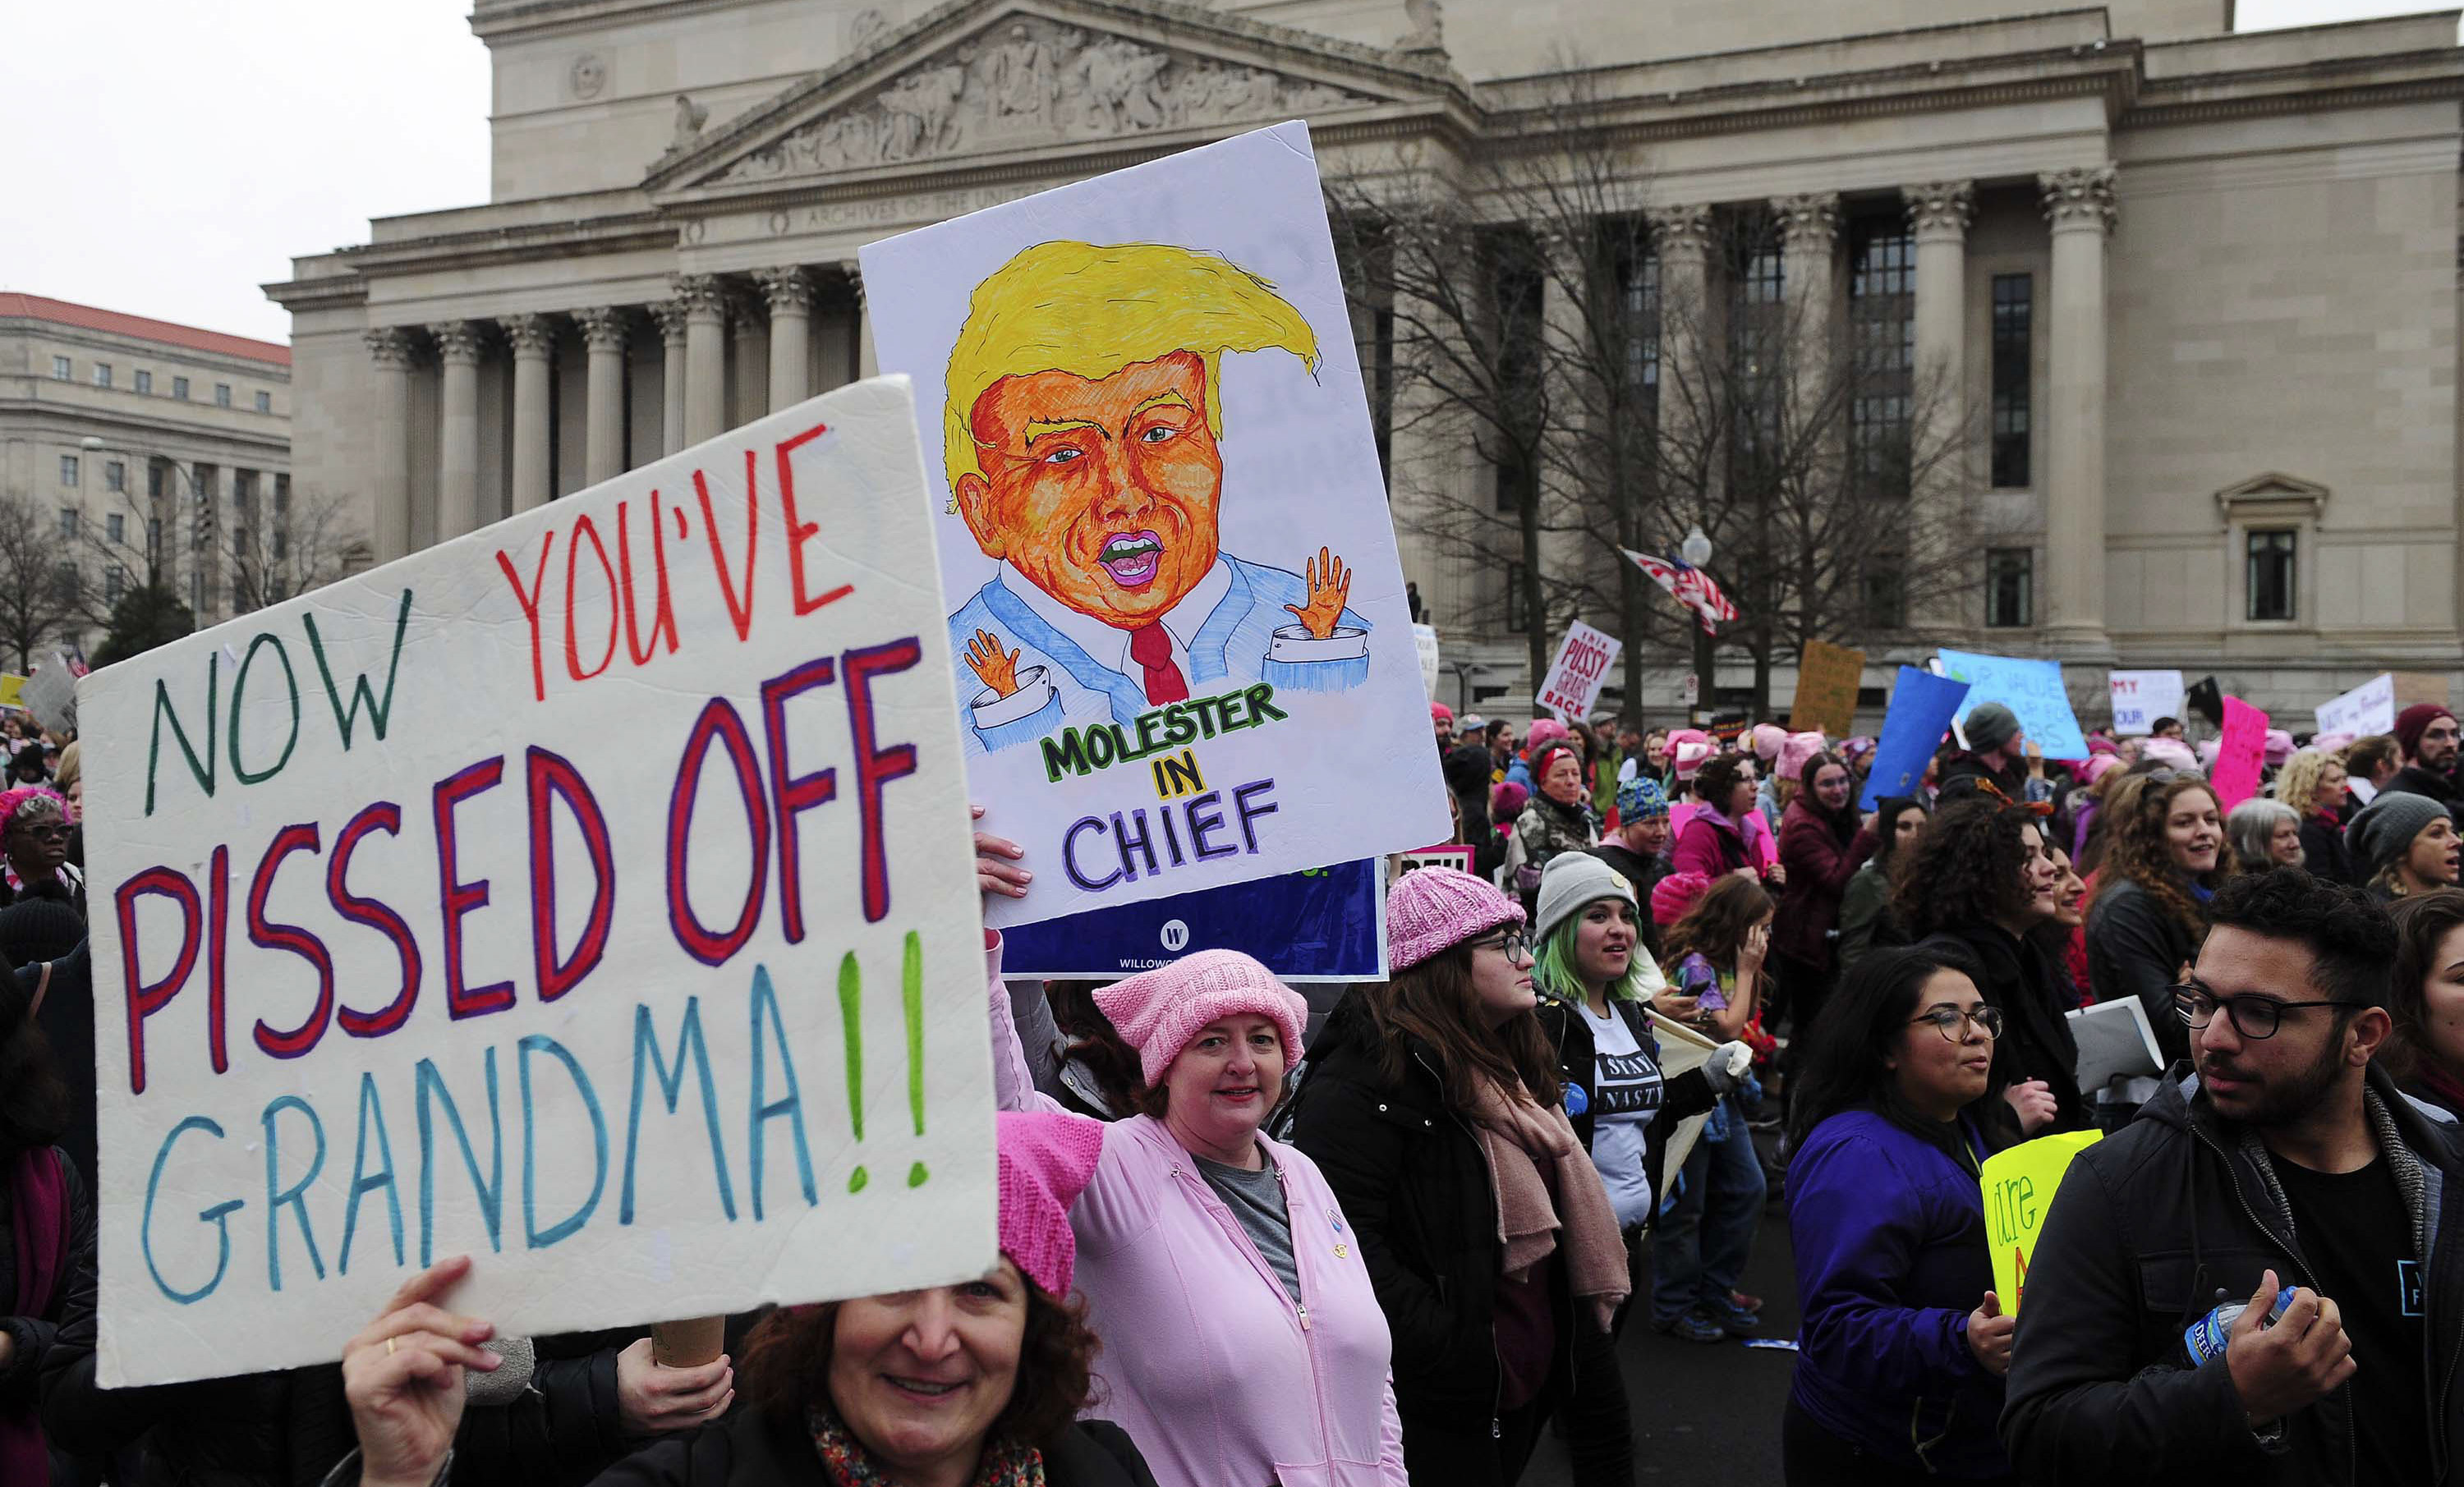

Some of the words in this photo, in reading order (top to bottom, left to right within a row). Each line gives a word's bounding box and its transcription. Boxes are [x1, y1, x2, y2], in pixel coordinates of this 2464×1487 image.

[807, 200, 898, 227] ARCHIVES
[903, 195, 929, 217] OF
[933, 191, 968, 213] THE
[145, 588, 412, 817] NOW
[496, 423, 855, 701] YOU'VE
[1561, 638, 1610, 681] PUSSY
[1544, 691, 1584, 717] BACK
[1040, 682, 1289, 783] MOLESTER
[1150, 747, 1206, 801] IN
[1061, 778, 1280, 893] CHIEF
[116, 745, 616, 1096] PISSED
[666, 636, 923, 968] OFF
[1607, 1055, 1653, 1076] STAY
[1604, 1085, 1663, 1110] NASTY
[1994, 1176, 2037, 1247] are
[2194, 1324, 2212, 1360] DEER
